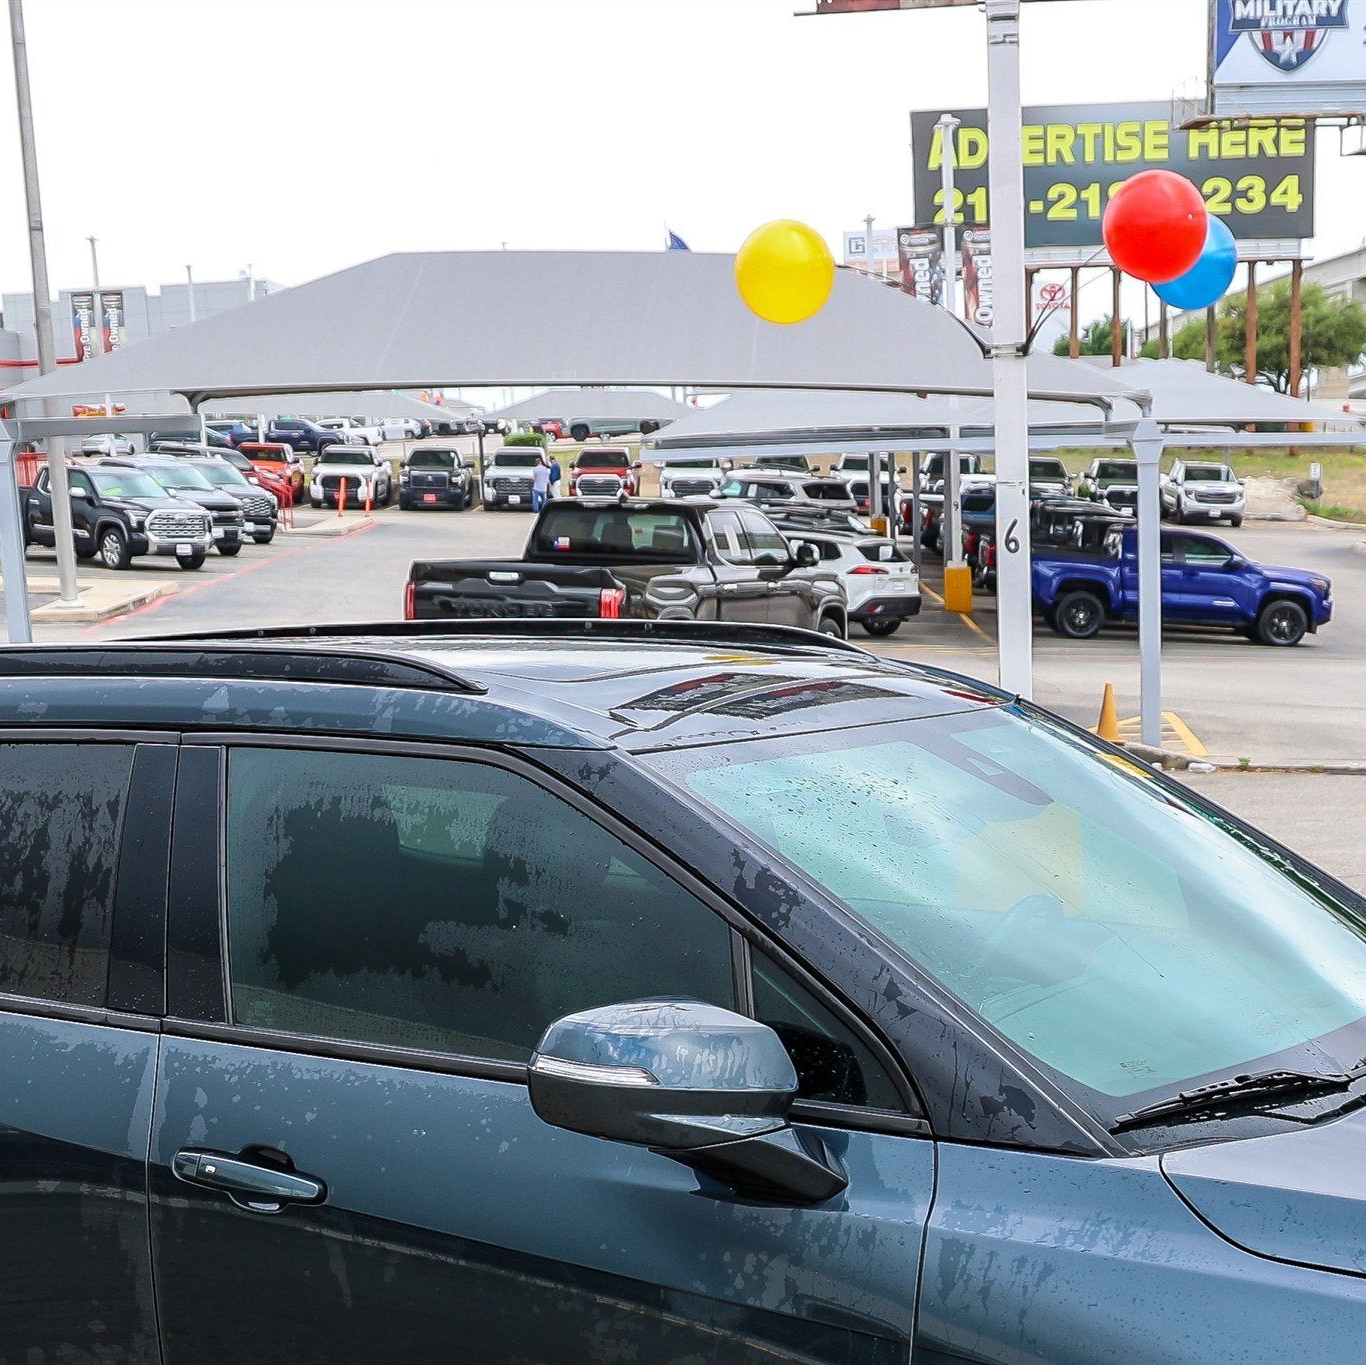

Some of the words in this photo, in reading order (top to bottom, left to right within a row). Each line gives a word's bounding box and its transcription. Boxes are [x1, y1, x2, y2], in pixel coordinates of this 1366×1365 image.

[927, 119, 1169, 171] ADERTISE
[1188, 117, 1307, 160] HERE
[1004, 518, 1020, 554] 6
